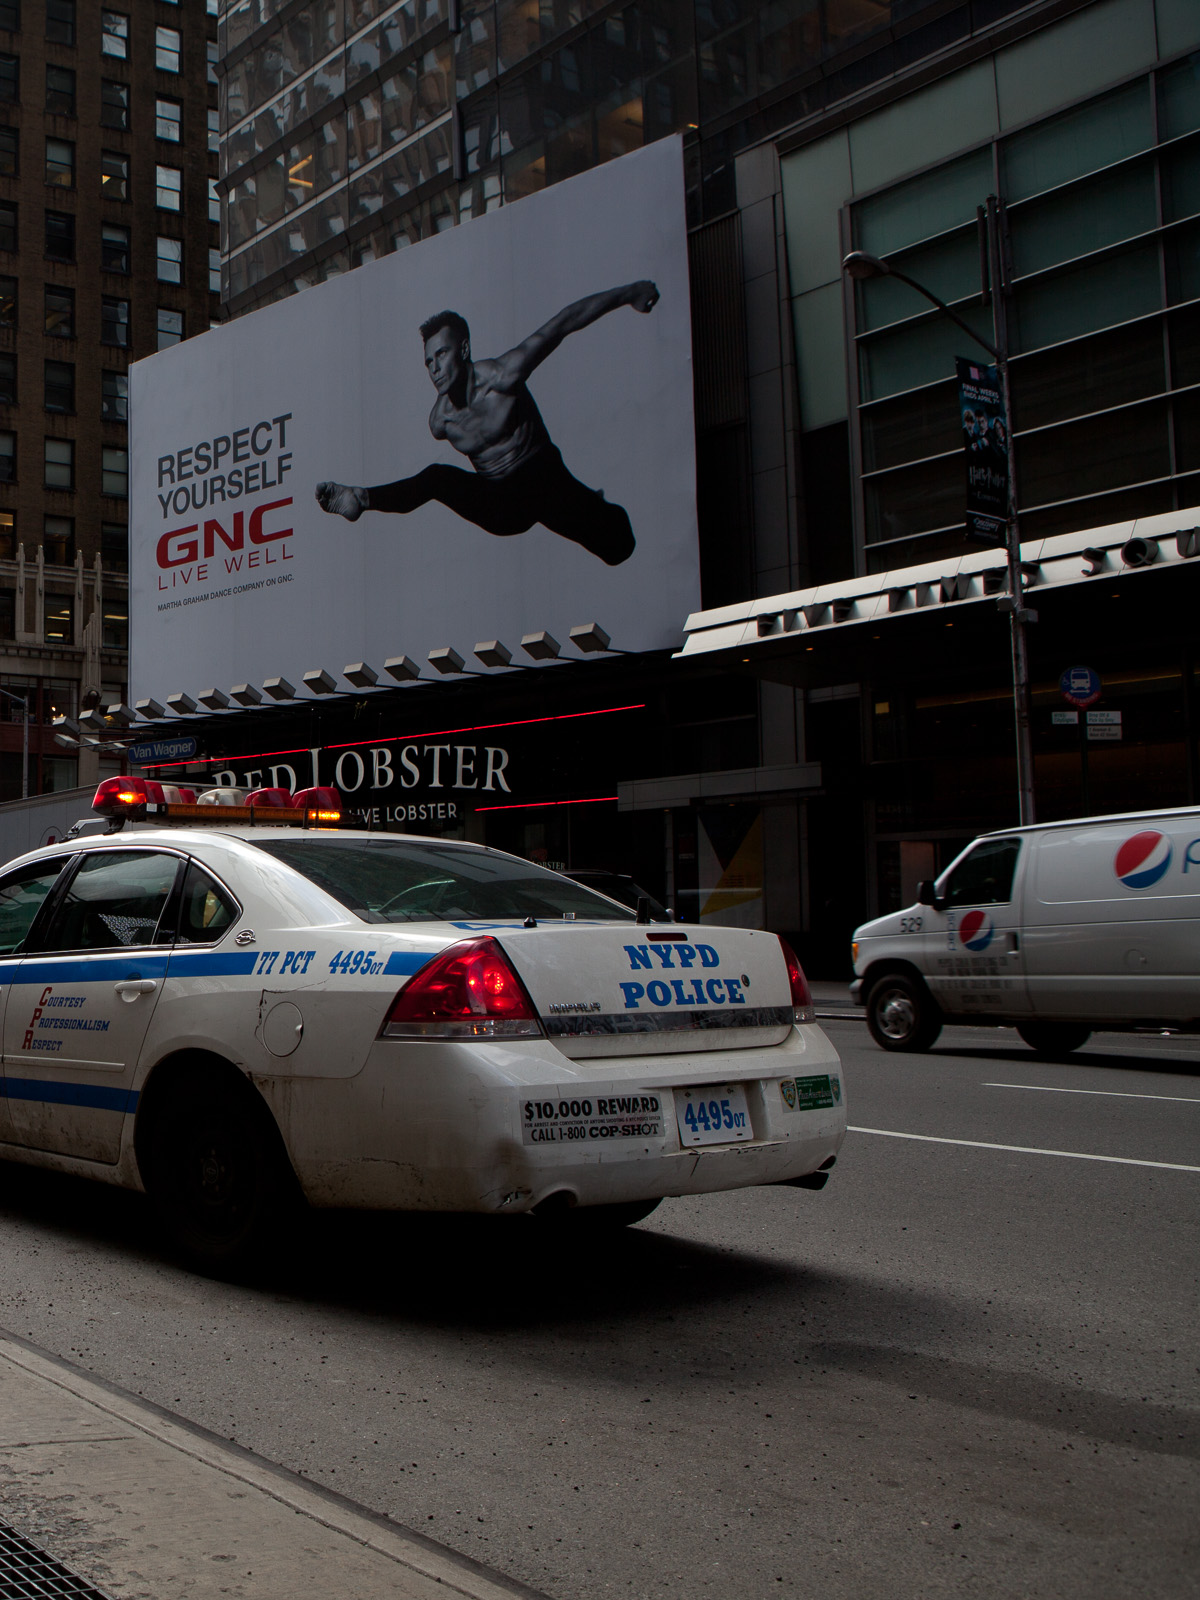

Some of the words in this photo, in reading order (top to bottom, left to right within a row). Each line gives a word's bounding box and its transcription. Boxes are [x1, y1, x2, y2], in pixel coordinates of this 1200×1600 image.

[158, 412, 292, 488] RESPECT
[158, 452, 292, 519] YOURSELF
[156, 496, 293, 569] GNC
[159, 564, 208, 591] LIVE
[225, 544, 293, 573] WELL
[158, 600, 182, 612] MARTHA
[183, 593, 209, 606] GRAHAM
[211, 588, 232, 600] DANCE
[233, 580, 265, 595] COMPANY
[266, 578, 276, 587] ON
[278, 573, 294, 584] GNC.
[756, 598, 853, 637] FIVE
[883, 561, 1040, 613] TIMES
[133, 746, 152, 759] Van
[153, 742, 193, 758] Wagner
[307, 743, 512, 793] LOBSTER
[386, 803, 458, 823] LOBSTER
[901, 916, 922, 933] 529
[257, 951, 280, 975] 77
[280, 951, 317, 974] PCT
[623, 944, 720, 970] NYPD
[39, 987, 86, 1008] COURTESY
[619, 979, 746, 1009] POLICE
[549, 1002, 601, 1013] IMPALA
[30, 1008, 111, 1032] PROFESSIONALISM
[22, 1029, 63, 1052] RESPECT
[525, 1100, 592, 1121] $10,000
[597, 1097, 659, 1115] REWARD
[531, 1128, 556, 1142] CALL
[559, 1126, 586, 1140] 1-800
[589, 1123, 659, 1138] COP-SHOT
